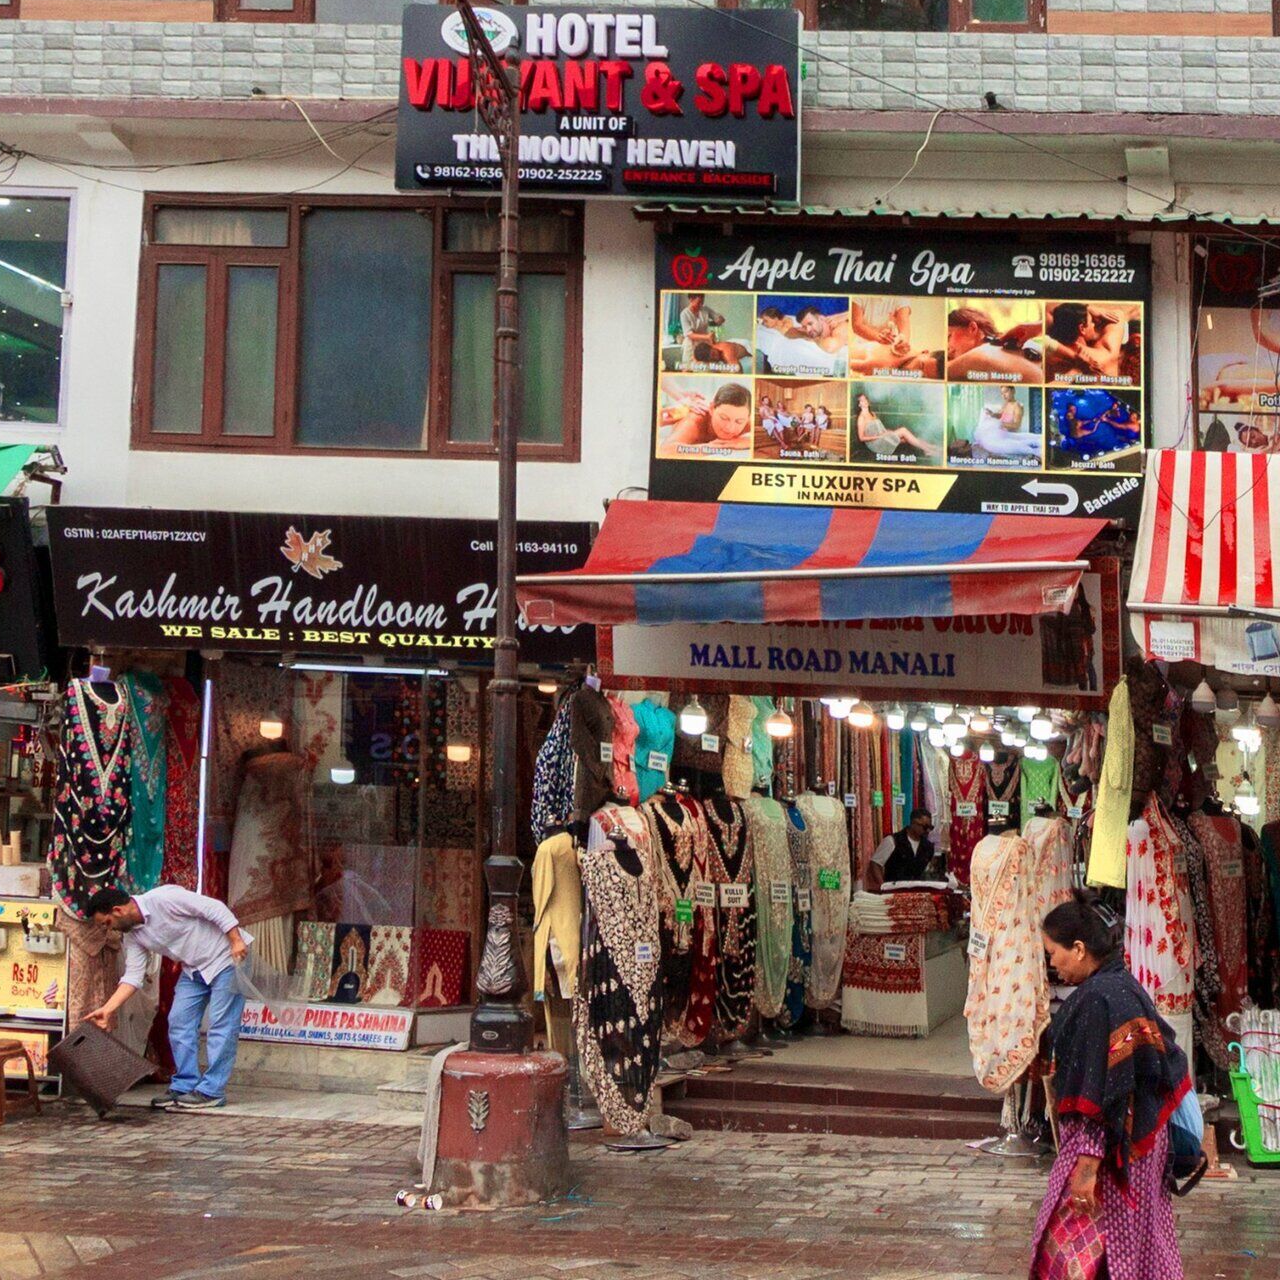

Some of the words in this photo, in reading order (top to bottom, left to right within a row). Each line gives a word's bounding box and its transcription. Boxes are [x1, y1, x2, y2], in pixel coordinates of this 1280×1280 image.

[525, 13, 669, 59] HOTEL
[639, 62, 686, 116] &
[693, 62, 796, 118] SPA
[560, 116, 570, 130] A
[571, 116, 605, 131] UNIT
[606, 117, 628, 131] OF
[517, 135, 616, 166] MOUNT
[626, 138, 737, 169] HEAVEN
[433, 166, 505, 179] 98162-1636
[517, 168, 603, 182] 01902-252225
[623, 171, 697, 185] ENTRANCE
[702, 173, 772, 188] BACKSIDE
[1039, 252, 1127, 269] 98169-16365
[718, 246, 816, 290] Apple
[827, 247, 898, 286] Thai
[909, 249, 976, 294] Spa
[1038, 267, 1137, 285] 01902-252227
[708, 363, 740, 373] Massage
[773, 364, 797, 374] Couple
[799, 365, 831, 375] Massage
[891, 369, 923, 379] Massage
[967, 370, 988, 381] Stone
[990, 371, 1023, 382] Massage
[1055, 373, 1073, 384] Deep
[1075, 373, 1097, 384] Tissue
[1099, 375, 1133, 386] Massage
[701, 446, 732, 456] Massage
[780, 449, 802, 458] Sauna
[804, 450, 820, 459] Bath
[875, 453, 898, 463] Steam
[900, 454, 917, 463] Bath
[950, 456, 985, 466] Moroccan
[987, 457, 1020, 466] Hammam
[1022, 458, 1039, 467] Bath
[1071, 460, 1096, 470] Jacuzzi
[1097, 461, 1116, 470] Bath
[751, 473, 797, 489] BEST
[801, 475, 878, 493] LUXURY
[882, 478, 922, 494] SPA
[797, 490, 810, 502] IN
[812, 490, 866, 504] MANALI
[1082, 476, 1140, 514] Backside
[985, 503, 1000, 514] WAY
[1001, 504, 1010, 514] TO
[1011, 505, 1030, 515] APPLE
[1032, 505, 1047, 515] THAI
[1048, 505, 1061, 515] SPA
[64, 528, 94, 539] GSTIN
[470, 540, 494, 552] Cell
[76, 571, 243, 622] Kashmir
[251, 575, 448, 629] Handloom
[161, 624, 203, 639] WE
[211, 626, 280, 641] SALE
[303, 629, 371, 645] BEST
[378, 631, 497, 650] QUALITY
[690, 643, 763, 671] MALL
[767, 645, 843, 674] ROAD
[848, 649, 956, 678] MANALI
[725, 887, 744, 897] KULLU
[727, 896, 742, 905] SUIT
[12, 963, 25, 983] Rs
[26, 964, 39, 984] 50
[11, 985, 43, 1001] Softy
[304, 1008, 338, 1028] PURE
[339, 1011, 408, 1033] PASHMINA
